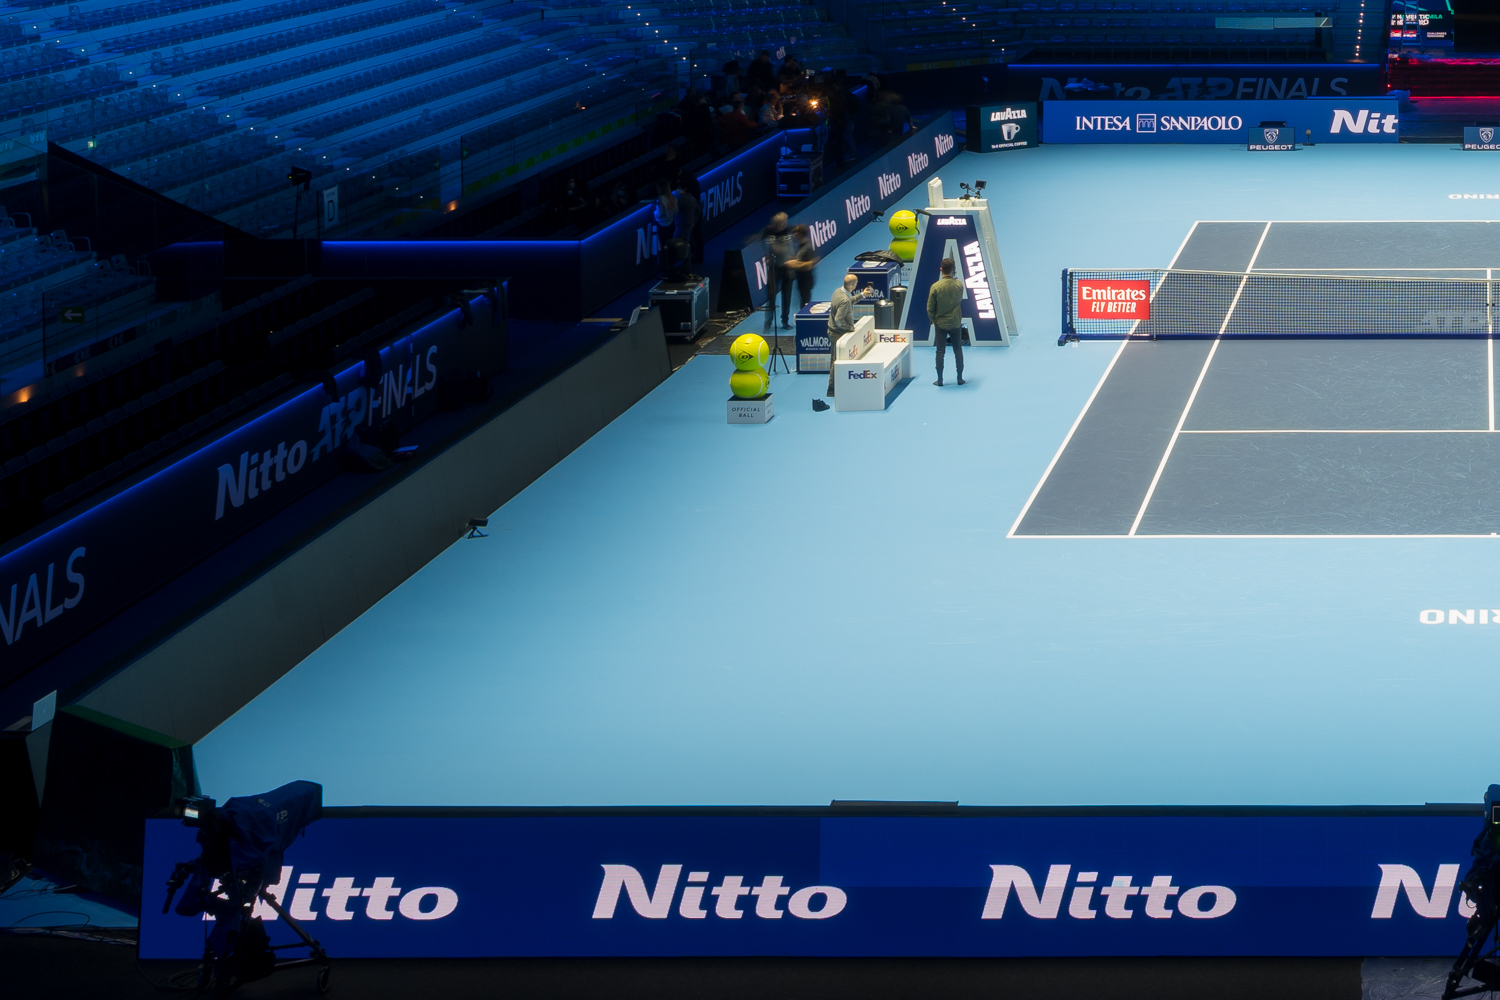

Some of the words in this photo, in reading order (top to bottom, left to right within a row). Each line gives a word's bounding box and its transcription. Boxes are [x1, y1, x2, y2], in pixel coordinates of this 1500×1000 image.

[990, 108, 1027, 122] LAVAZZA
[1075, 115, 1131, 131] INTESA
[1160, 115, 1242, 131] SANPAOLO
[934, 133, 954, 158] Nitto
[908, 152, 929, 178] Nitto
[706, 171, 743, 222] FINALS
[878, 171, 902, 200] Nitto
[845, 193, 871, 224] Nitto
[809, 219, 837, 251] Nitto
[963, 241, 996, 319] LAVAZZA
[1082, 286, 1146, 302] Emirates
[1091, 302, 1106, 313] FLY
[1107, 302, 1137, 313] BETTER
[879, 334, 906, 343] FedEx
[848, 370, 877, 379] FedEx
[215, 440, 306, 521] Nitto
[367, 345, 438, 427] FINALS
[592, 864, 848, 920] Nitto
[981, 863, 1237, 920] Nitto
